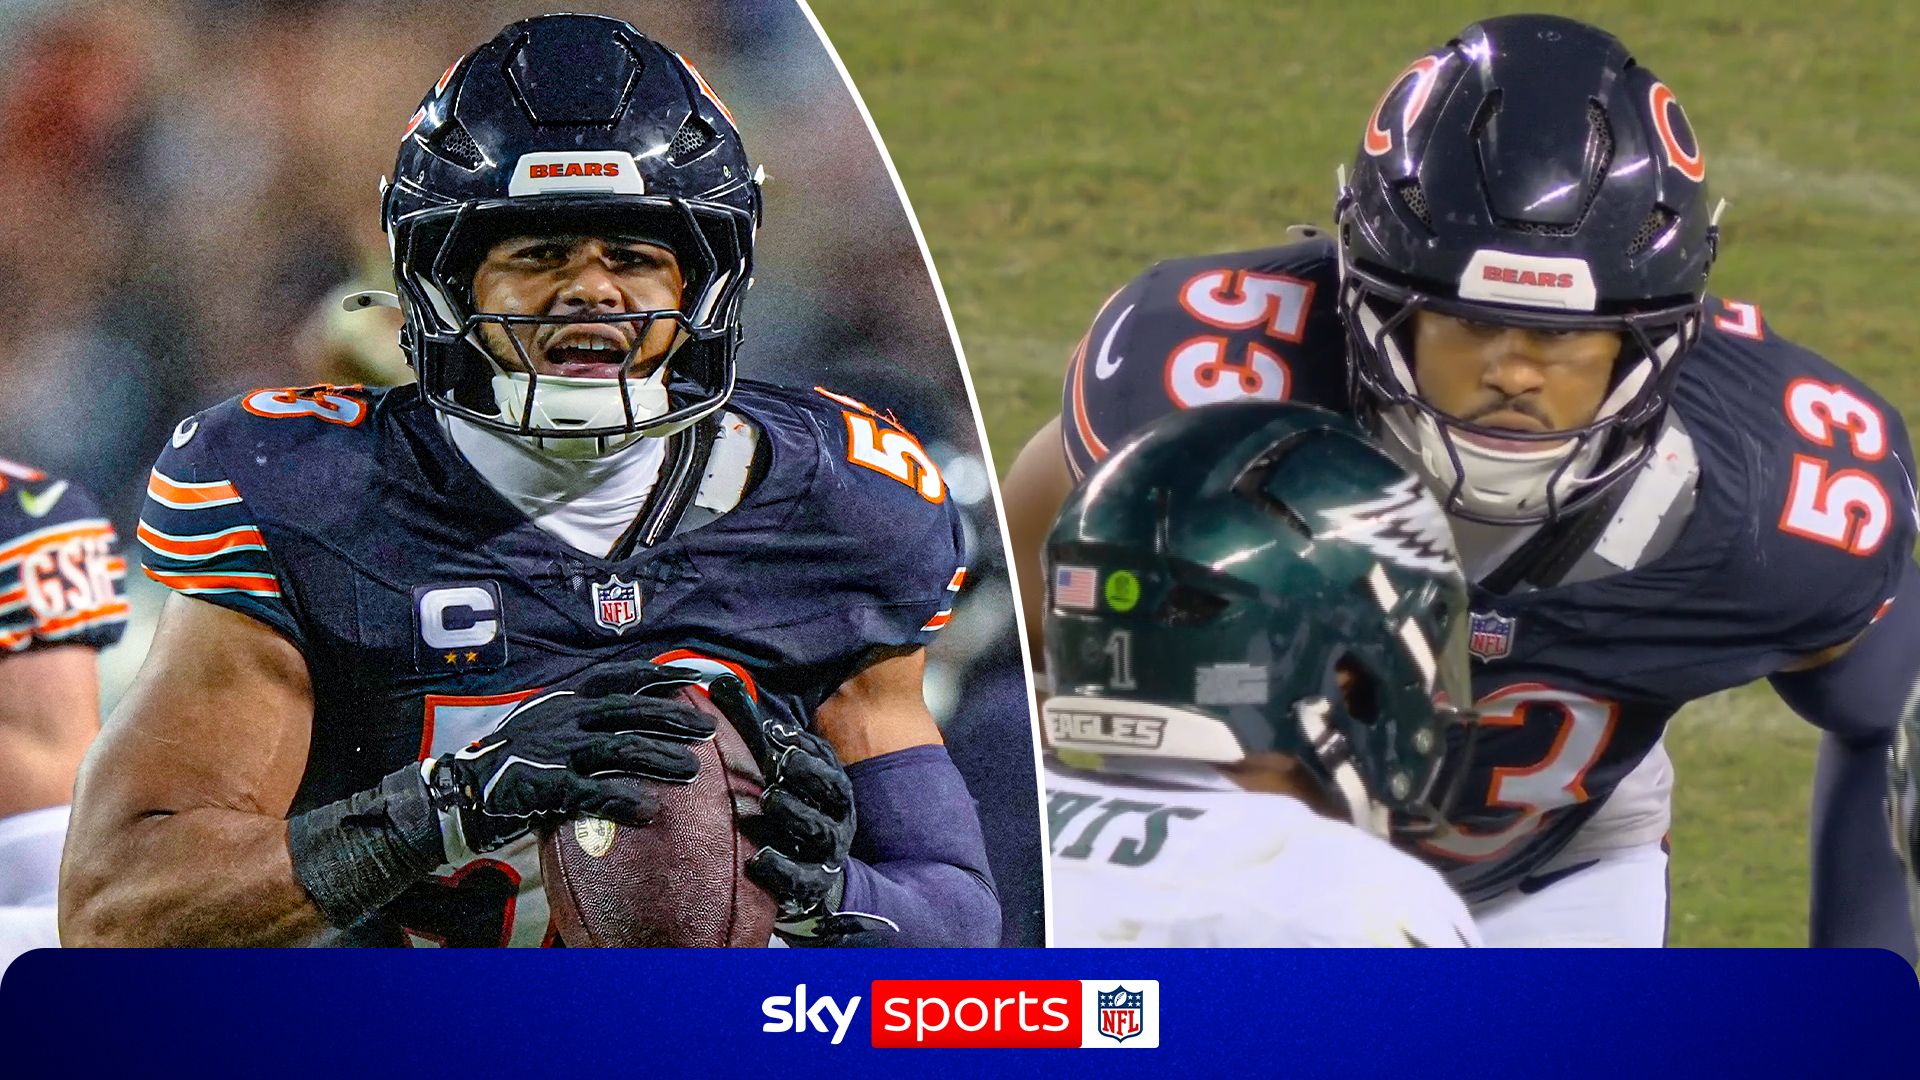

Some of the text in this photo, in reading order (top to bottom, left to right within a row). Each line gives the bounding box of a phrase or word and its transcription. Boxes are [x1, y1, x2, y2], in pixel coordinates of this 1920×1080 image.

[529, 163, 619, 178] BEARS
[1482, 265, 1574, 288] BEARS
[1163, 268, 1316, 410] 53
[814, 386, 946, 504] 5
[1778, 376, 1892, 557] 53
[421, 587, 497, 649] C
[602, 601, 634, 623] NFL
[1471, 633, 1507, 652] NFL
[1105, 629, 1137, 691] 1
